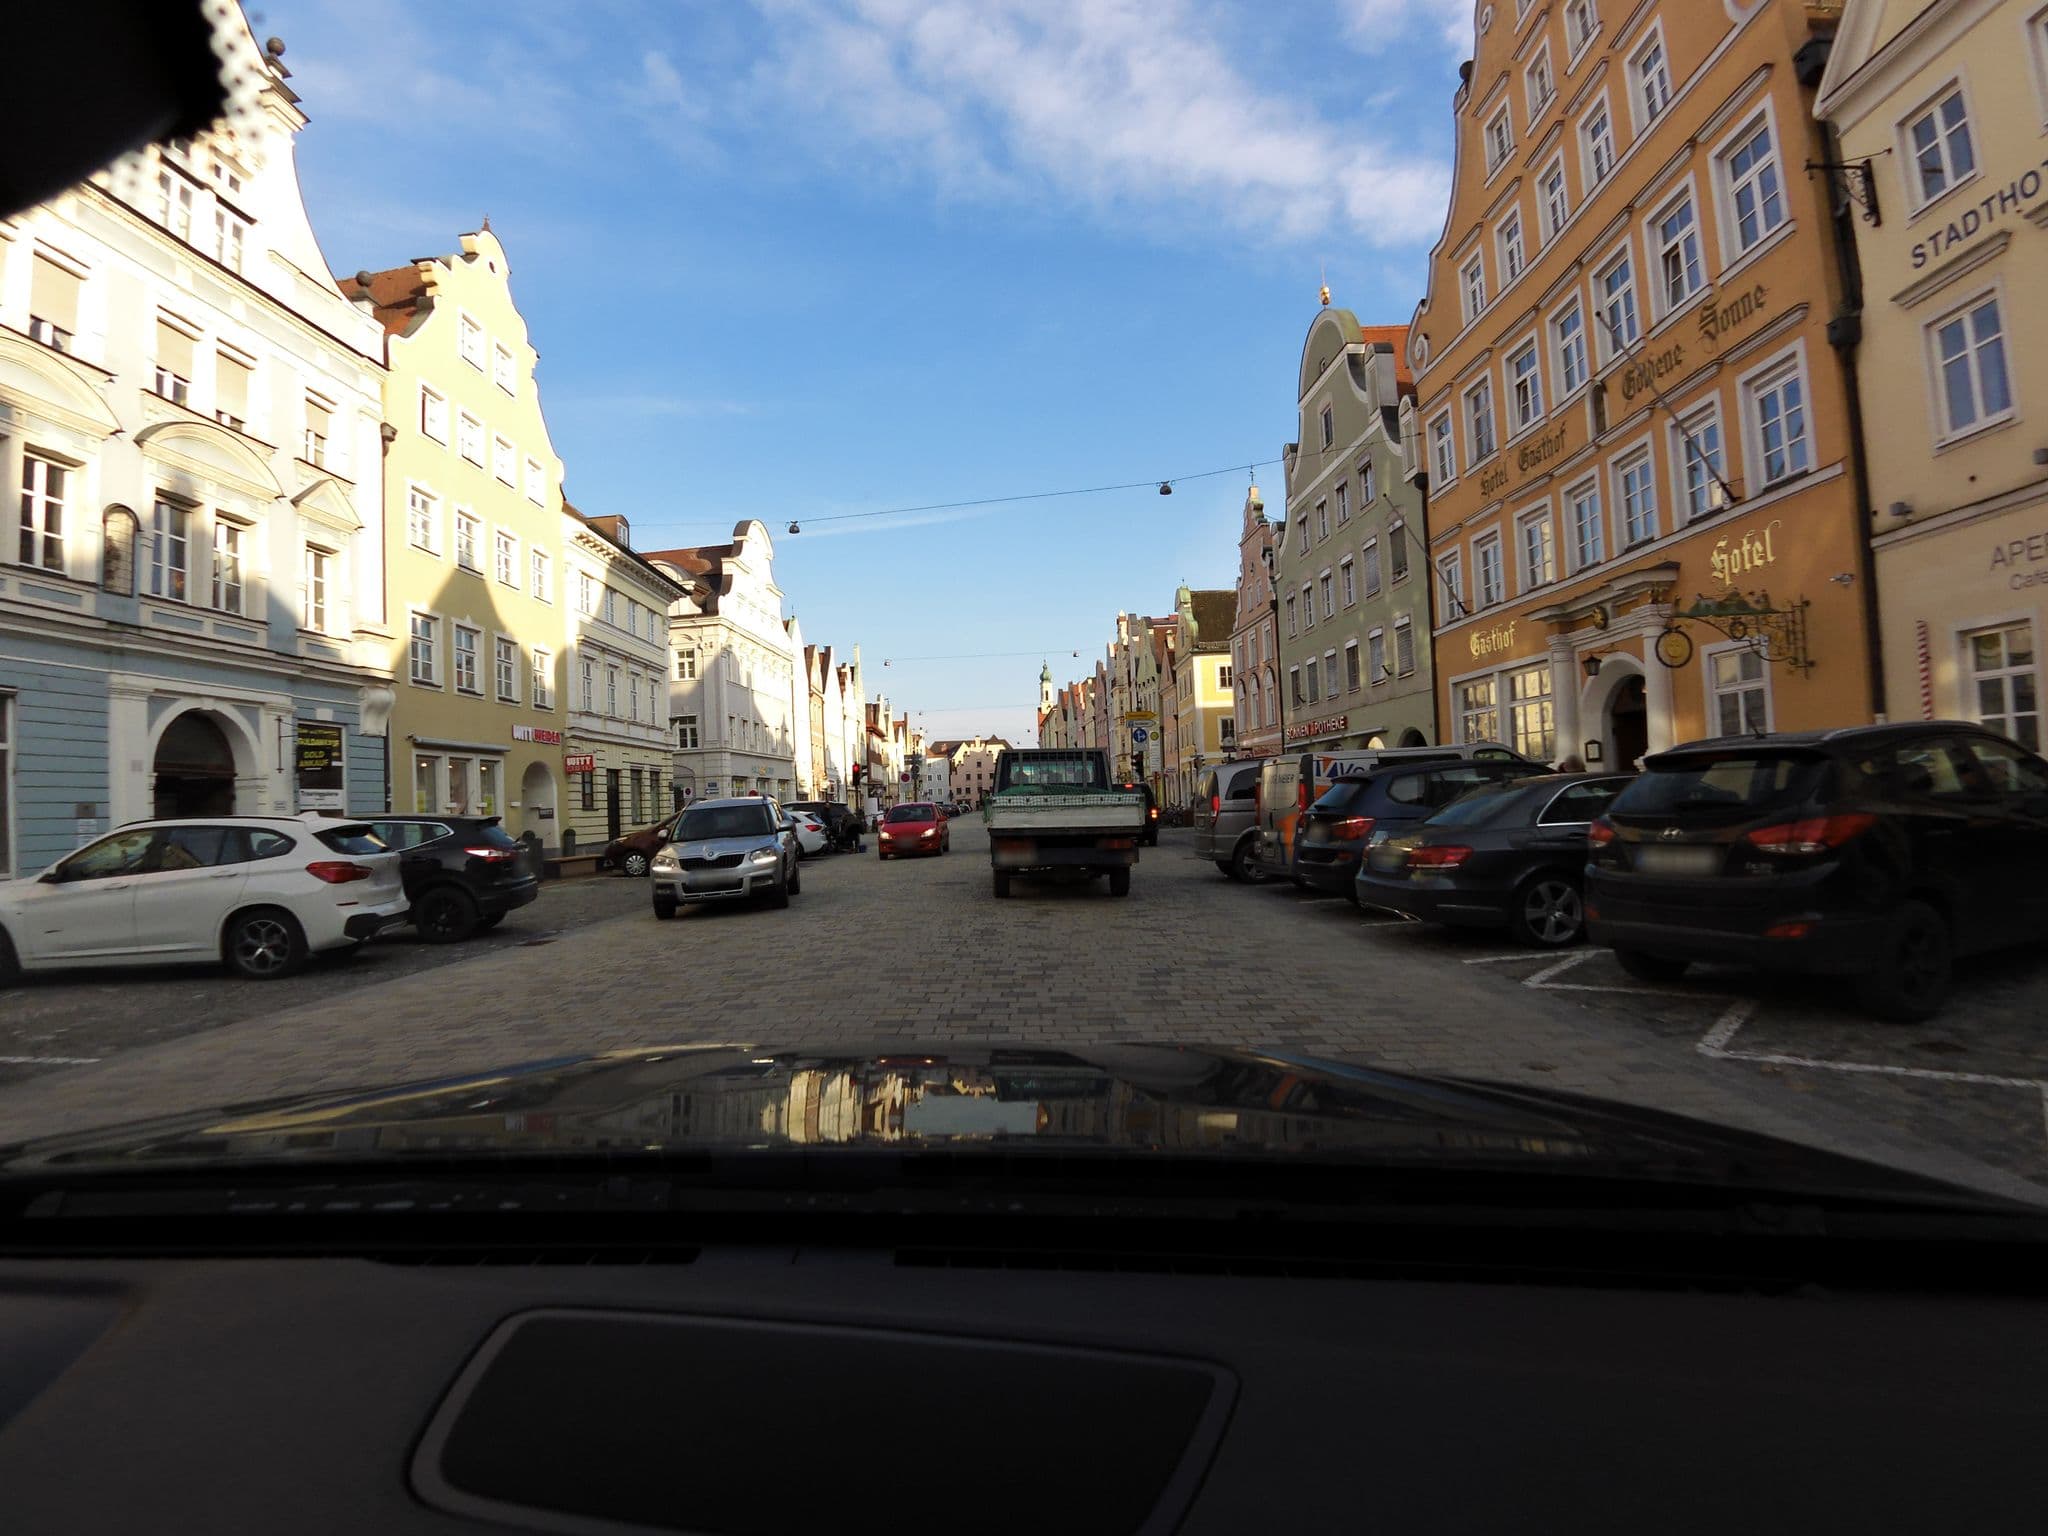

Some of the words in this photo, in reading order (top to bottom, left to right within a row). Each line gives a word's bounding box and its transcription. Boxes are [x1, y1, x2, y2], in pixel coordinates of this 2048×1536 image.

[1911, 158, 2048, 270] STADTHO
[1518, 420, 1567, 473] Gasthof
[1696, 284, 1768, 350] Sonne
[1711, 519, 1781, 586] Hotel
[1989, 531, 2048, 571] APE
[1470, 620, 1517, 659] Gasthof
[512, 725, 534, 742] WITT
[534, 729, 561, 745] WEIDEN
[1310, 716, 1346, 735] APOTHEKE
[566, 756, 593, 766] WITT
